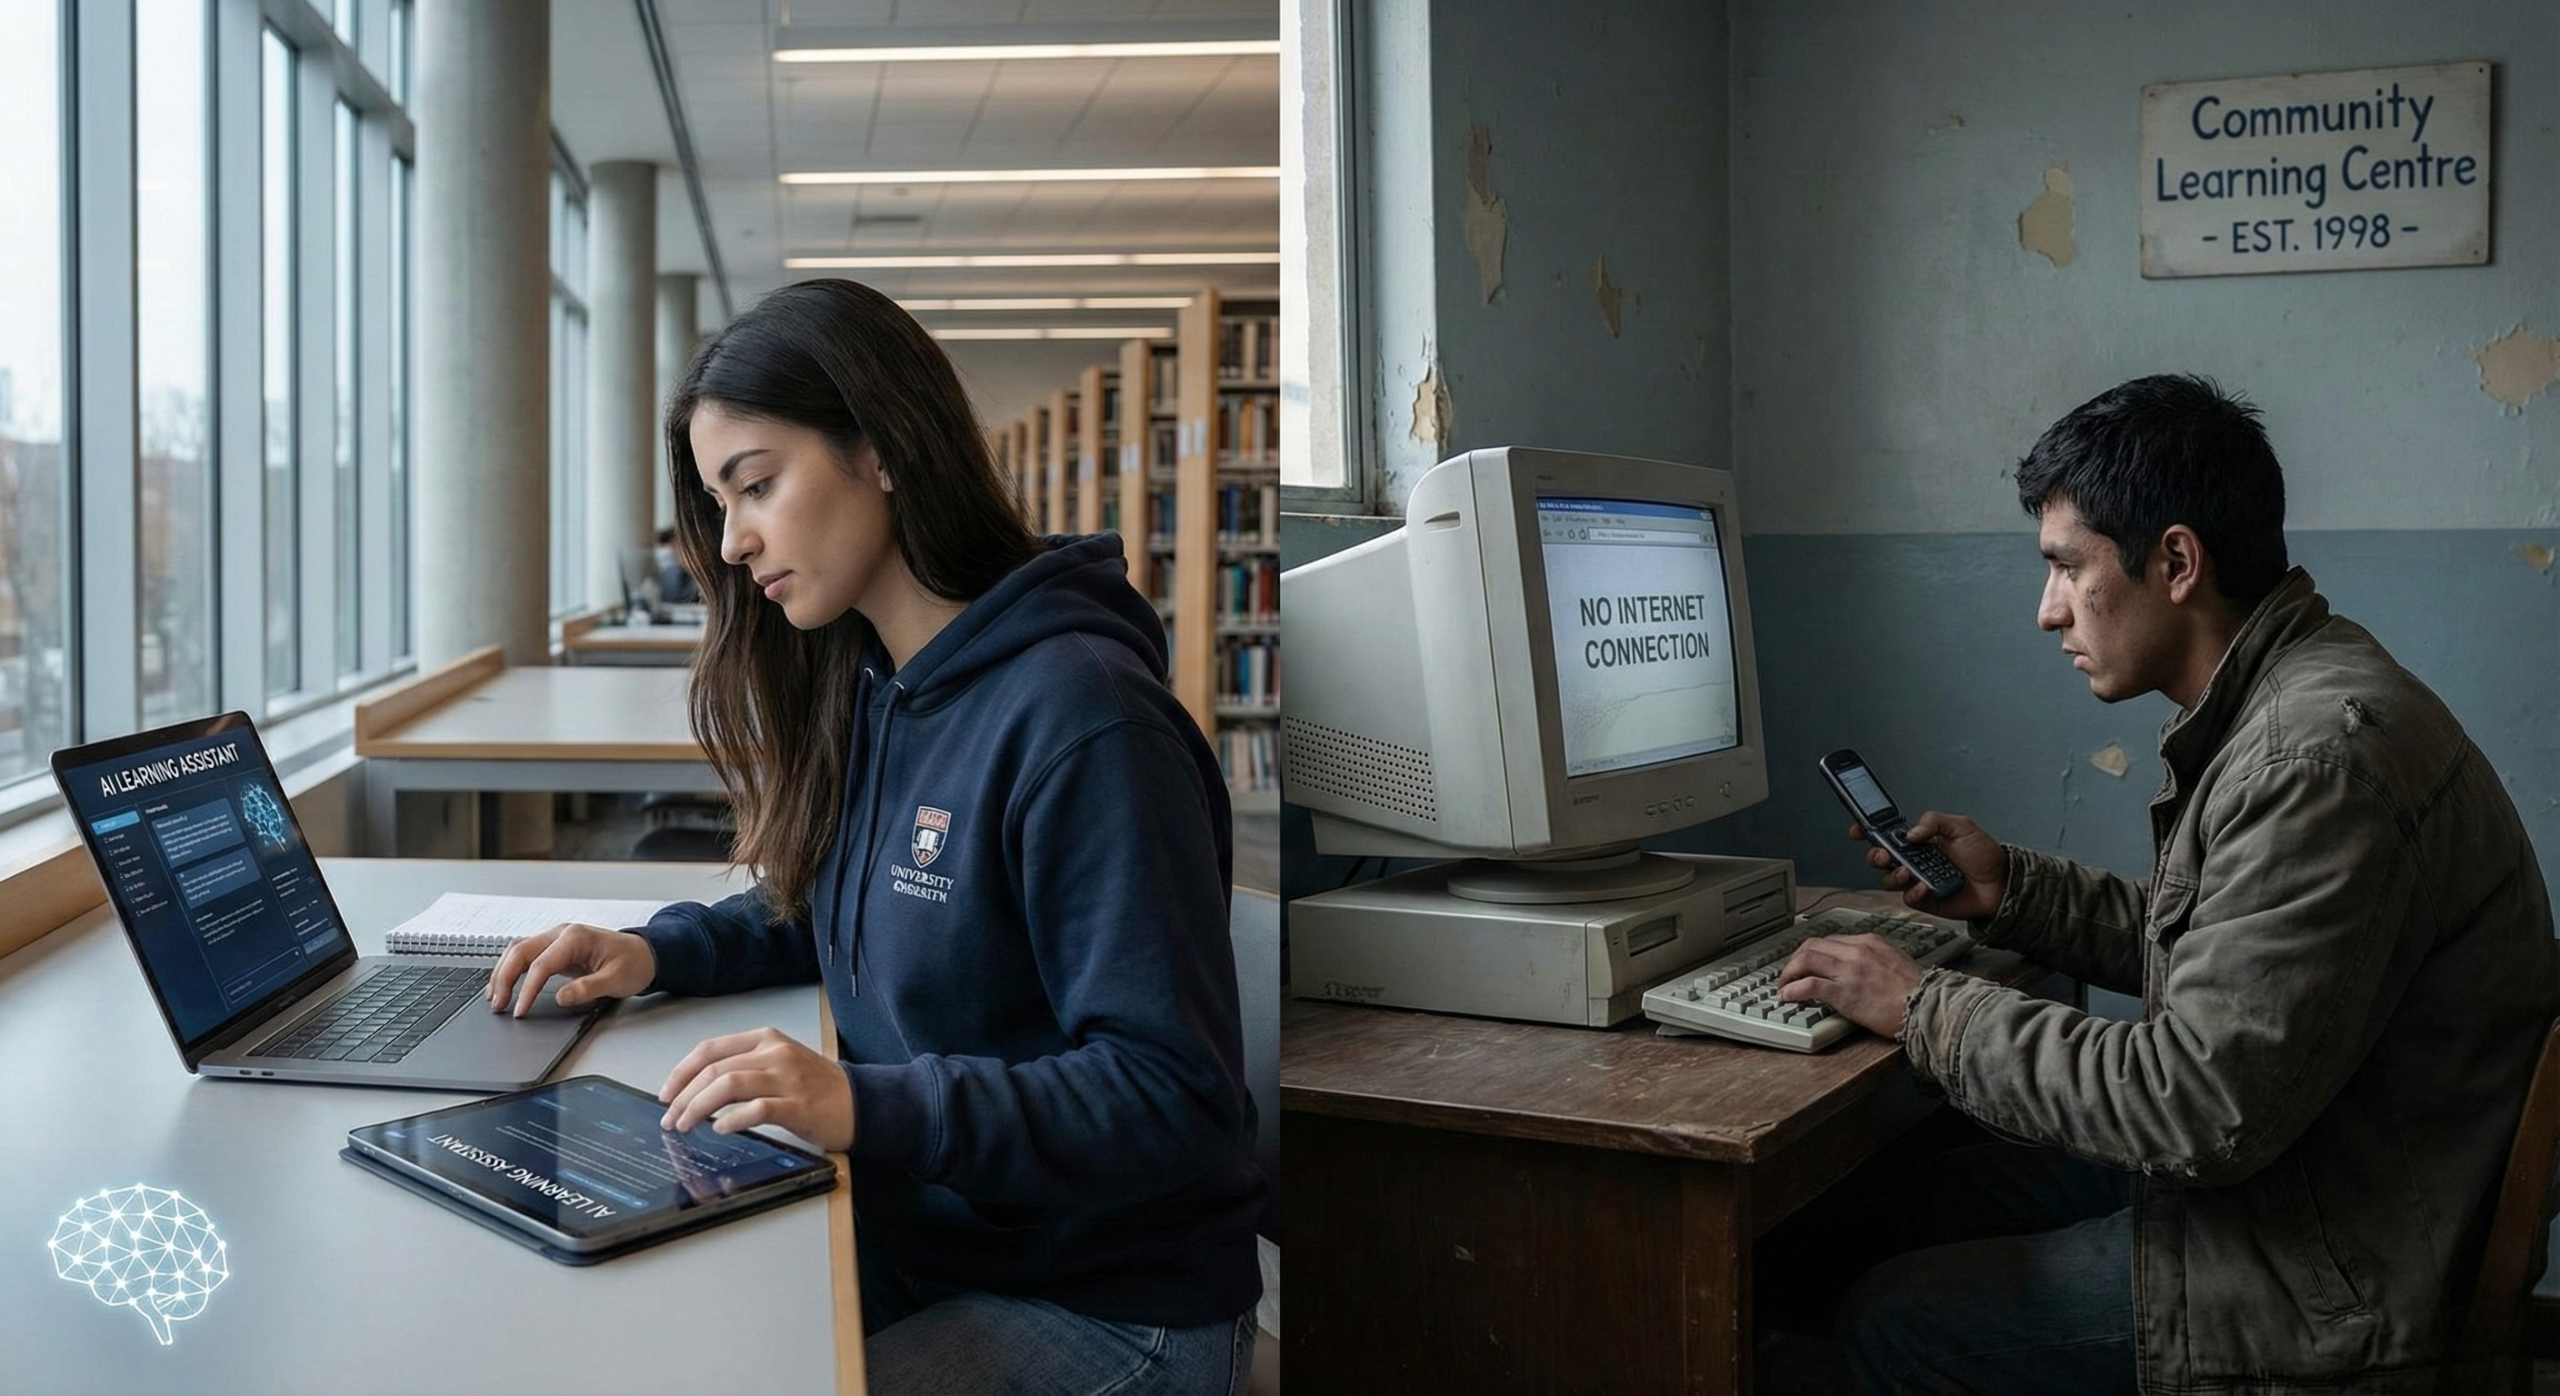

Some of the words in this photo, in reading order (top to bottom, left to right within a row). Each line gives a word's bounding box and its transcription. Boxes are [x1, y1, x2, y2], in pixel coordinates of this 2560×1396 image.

[2191, 82, 2435, 143] Community
[2156, 156, 2327, 210] Learning
[2341, 142, 2478, 192] Centre
[2231, 218, 2299, 254] EST.
[2313, 213, 2392, 251] 1998
[1580, 596, 1612, 627] NO
[1617, 594, 1705, 625] INTERNET
[1585, 631, 1710, 669] CONNECTION
[100, 774, 117, 798] AI
[114, 758, 180, 793] LEARNING
[179, 742, 240, 776] ASSISTANT
[890, 863, 955, 890] UNIVERSITY
[426, 1133, 516, 1172] ASSISTANT
[506, 1168, 595, 1210] LEARNING
[585, 1204, 617, 1219] AI
